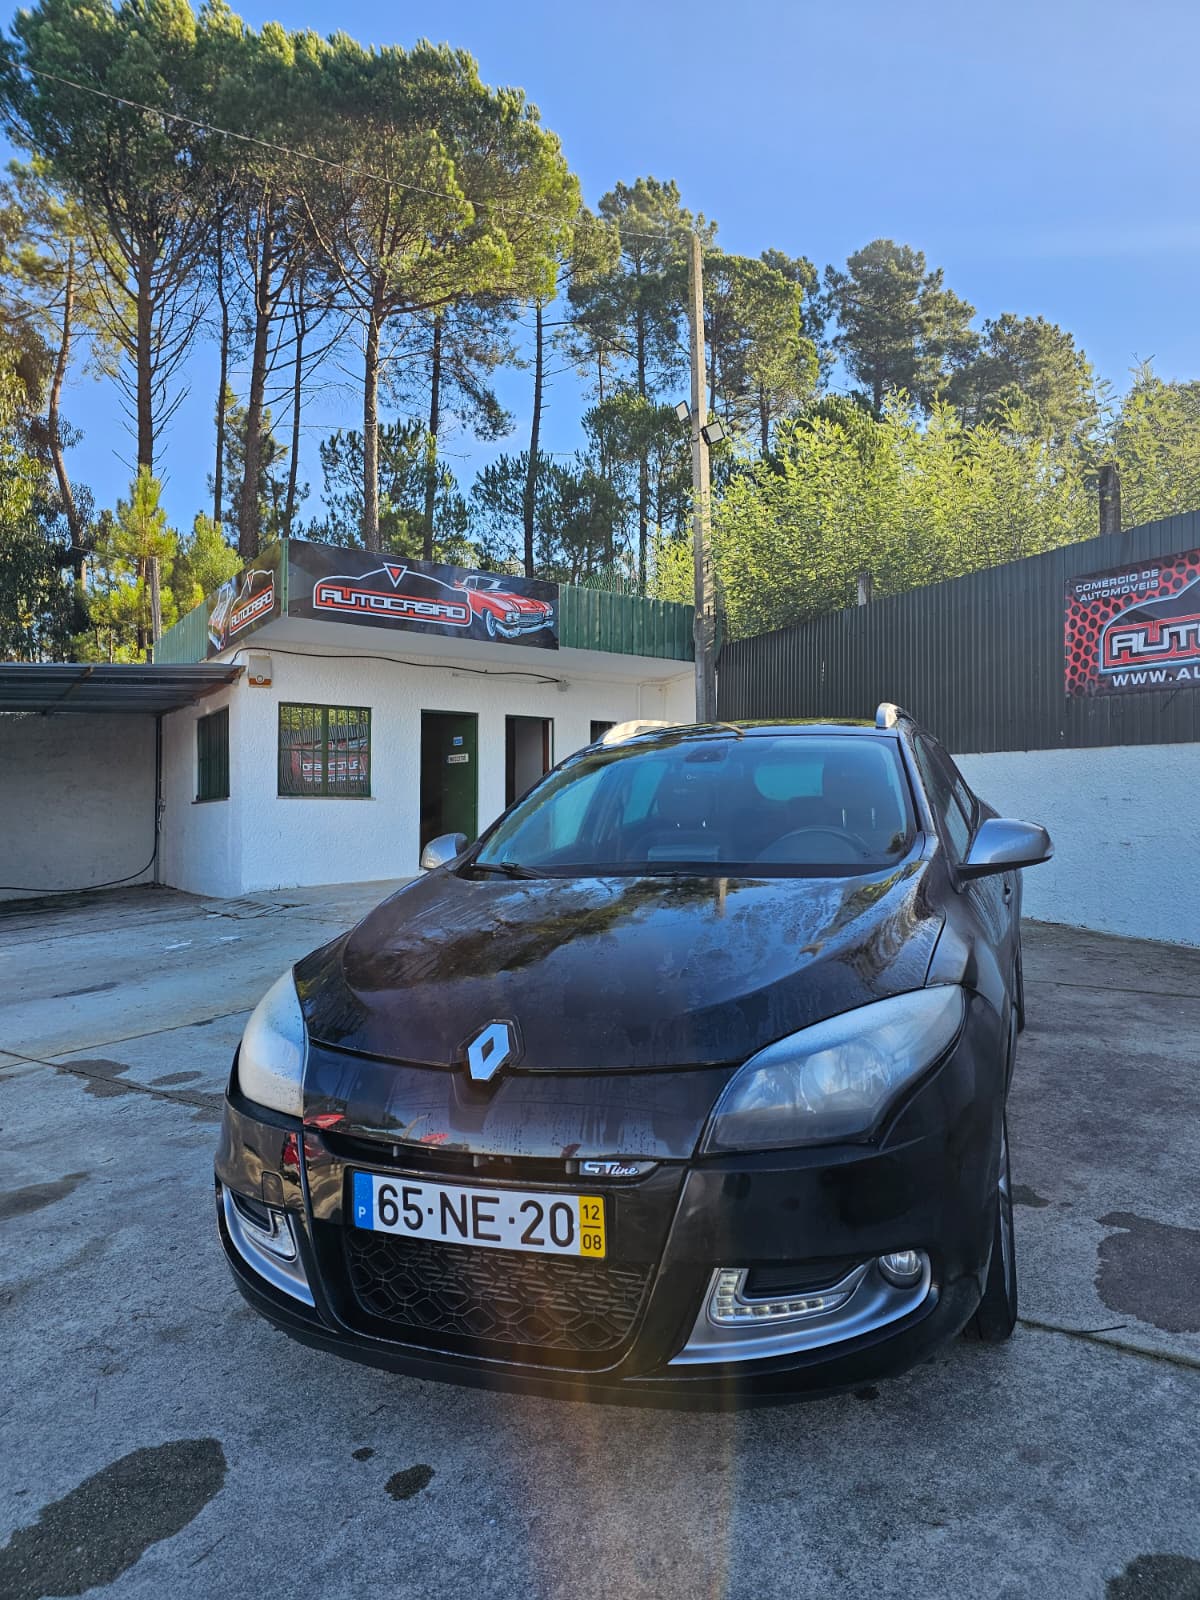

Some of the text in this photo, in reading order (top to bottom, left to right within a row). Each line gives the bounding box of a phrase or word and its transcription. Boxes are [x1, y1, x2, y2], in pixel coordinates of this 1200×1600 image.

[1075, 568, 1160, 593] COMÉRCIO DE
[1080, 579, 1159, 602] AUTOMÓVEIS
[1112, 623, 1200, 656] AUT
[358, 1205, 367, 1219] P
[582, 1204, 601, 1221] 12
[582, 1233, 603, 1251] 08
